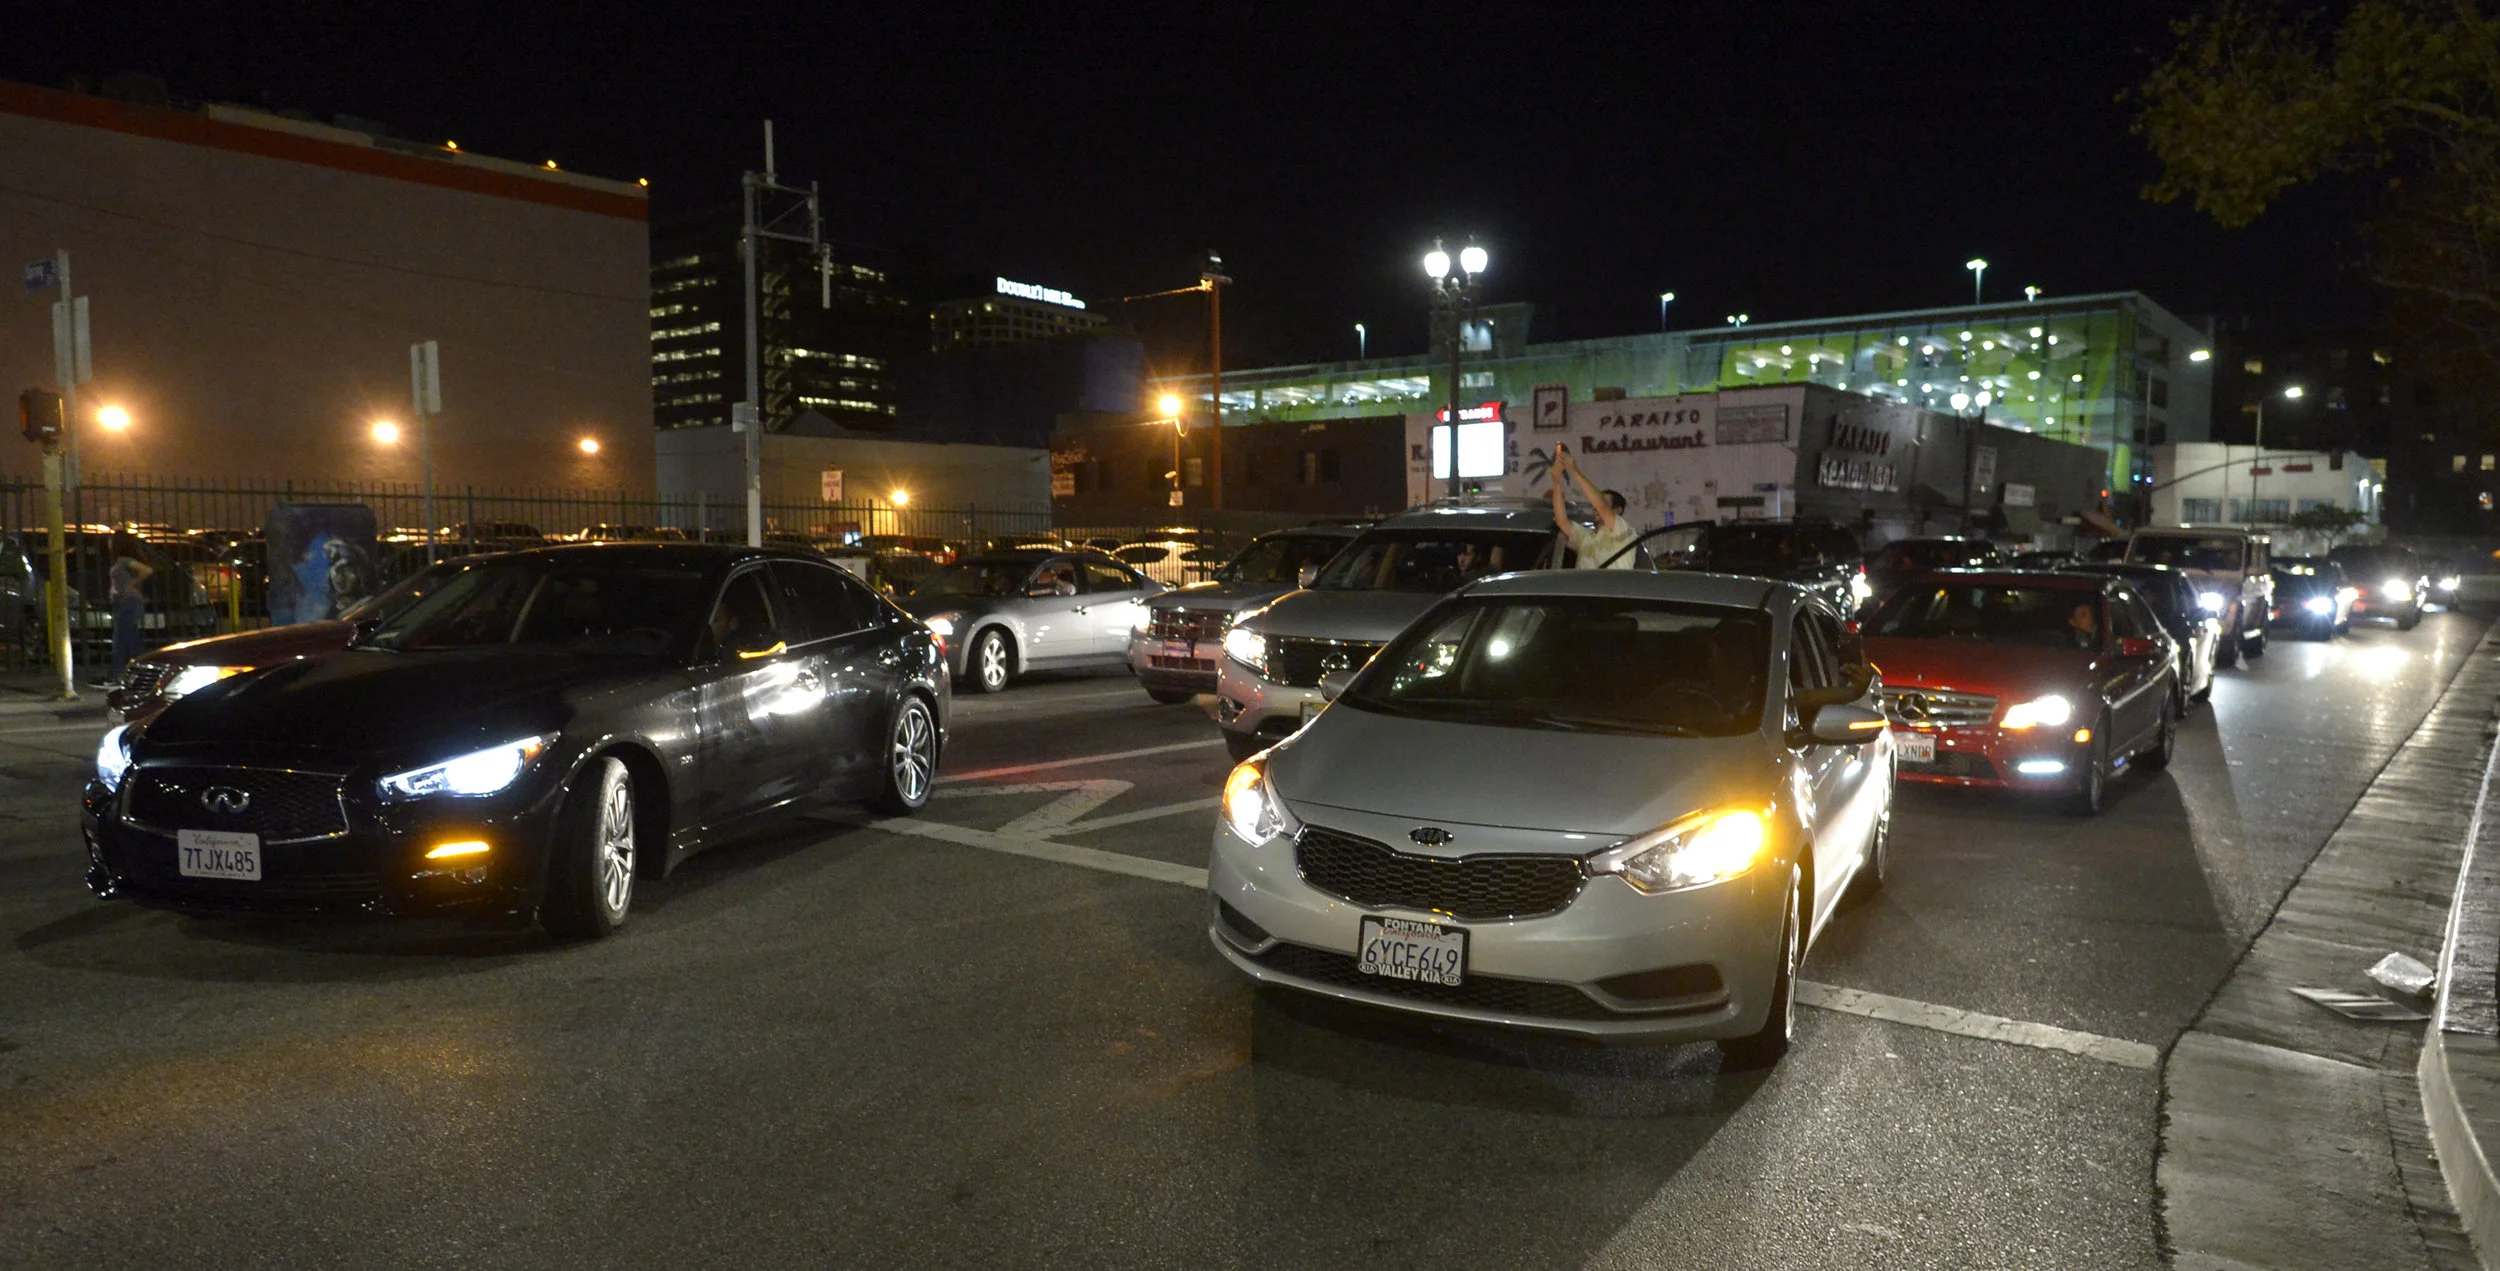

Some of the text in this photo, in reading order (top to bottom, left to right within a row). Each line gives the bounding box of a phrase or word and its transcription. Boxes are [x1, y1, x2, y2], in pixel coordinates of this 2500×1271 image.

[1598, 408, 1701, 430] PARAISO
[1581, 429, 1708, 454] Restaurant
[183, 847, 254, 872] 7TJX485
[1384, 918, 1441, 936] FONTANA
[1366, 938, 1458, 974] 6YCE649
[1379, 963, 1441, 984] VALLEY KIA
